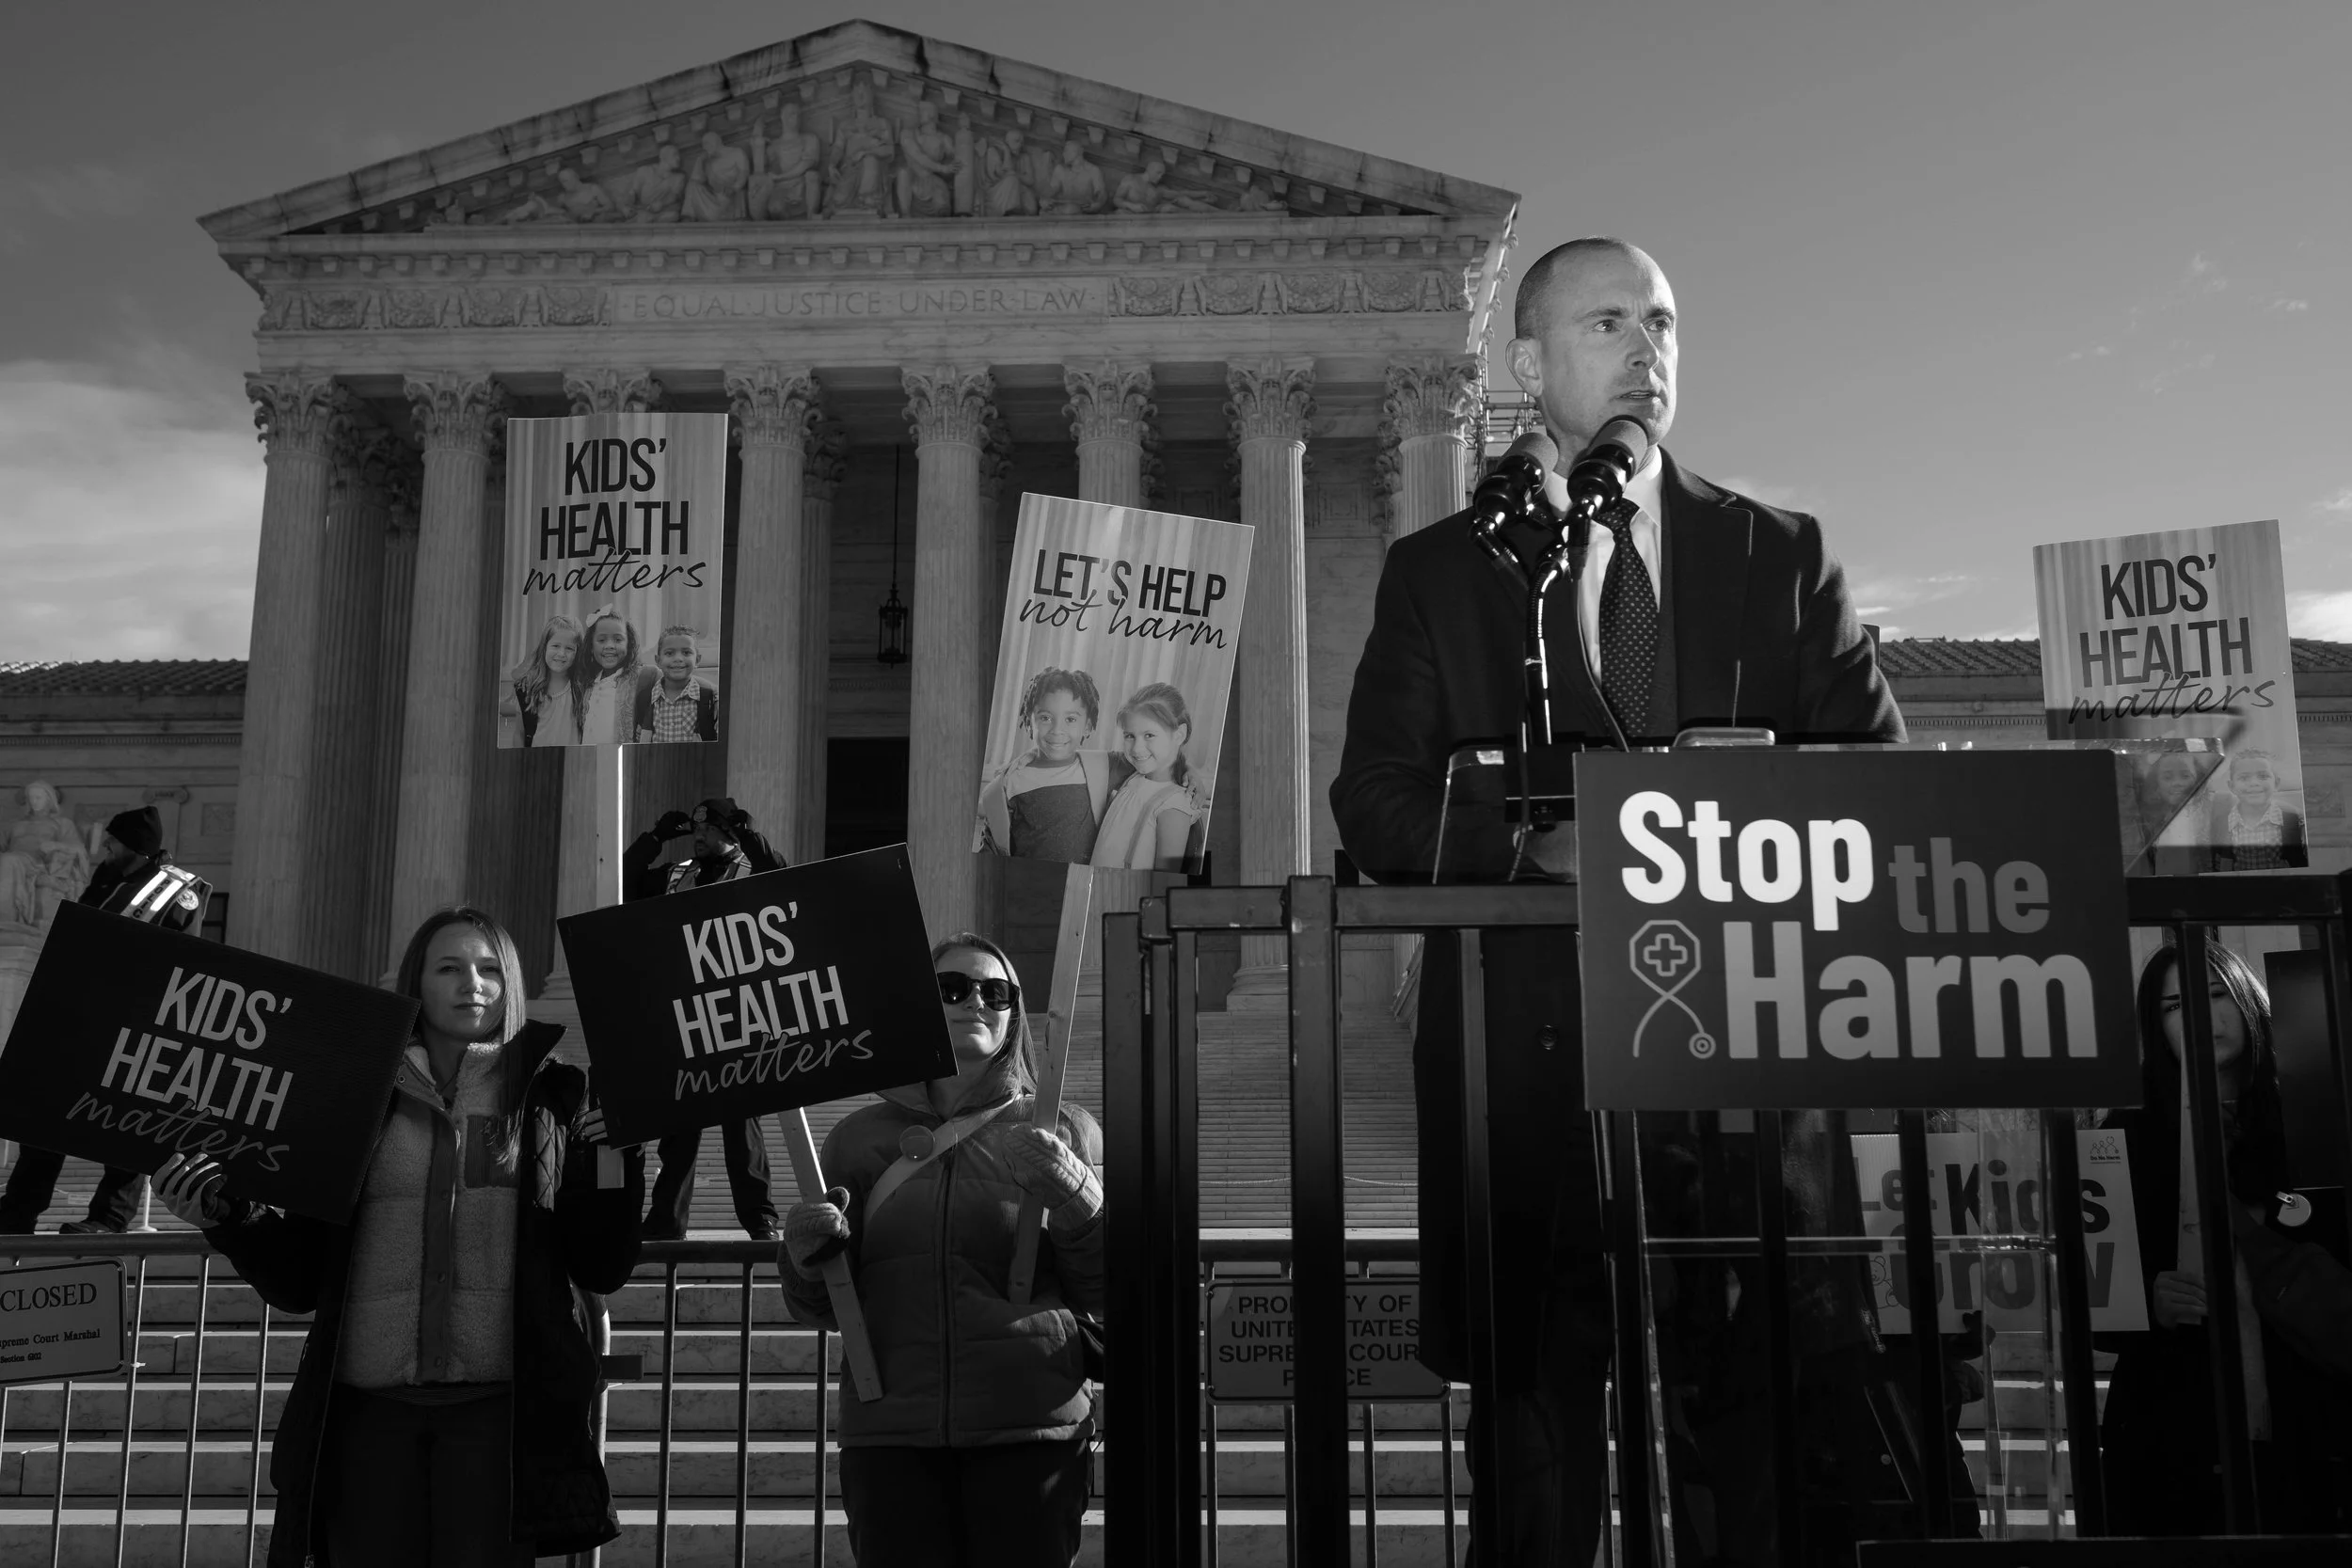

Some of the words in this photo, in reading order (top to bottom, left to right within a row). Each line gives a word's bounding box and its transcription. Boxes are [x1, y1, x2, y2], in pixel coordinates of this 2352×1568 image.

[634, 293, 744, 318] EQUAL
[752, 290, 882, 318] JUSTICE
[898, 288, 1014, 315] UNDER
[1022, 287, 1087, 311] LAW
[564, 438, 666, 495] KIDS'
[540, 501, 689, 560] HEALTH
[522, 547, 706, 594] matters
[1033, 549, 1132, 605] LET'S
[1138, 564, 1227, 617] HELP
[2101, 553, 2216, 620] KIDS'
[1020, 589, 1103, 632] not
[1108, 597, 1227, 649] harm
[2079, 617, 2252, 688] HEALTH
[2068, 673, 2276, 724] matters
[1618, 790, 1874, 931] Stop
[1888, 836, 2050, 933] the
[133, 879, 169, 919] POLIC
[682, 901, 798, 984] KIDS'
[154, 966, 293, 1050] KIDS'
[672, 965, 849, 1059] HEALTH
[1723, 920, 2098, 1060] Harm
[101, 1027, 294, 1131] HEALTH
[675, 1029, 874, 1101] matters
[65, 1091, 290, 1172] matters
[0, 1283, 97, 1312] CLOSED
[1379, 1294, 1411, 1312] OF
[33, 1333, 59, 1344] Court
[63, 1327, 101, 1341] Marshal
[1347, 1319, 1419, 1337] TATES
[1349, 1343, 1420, 1361] COUR
